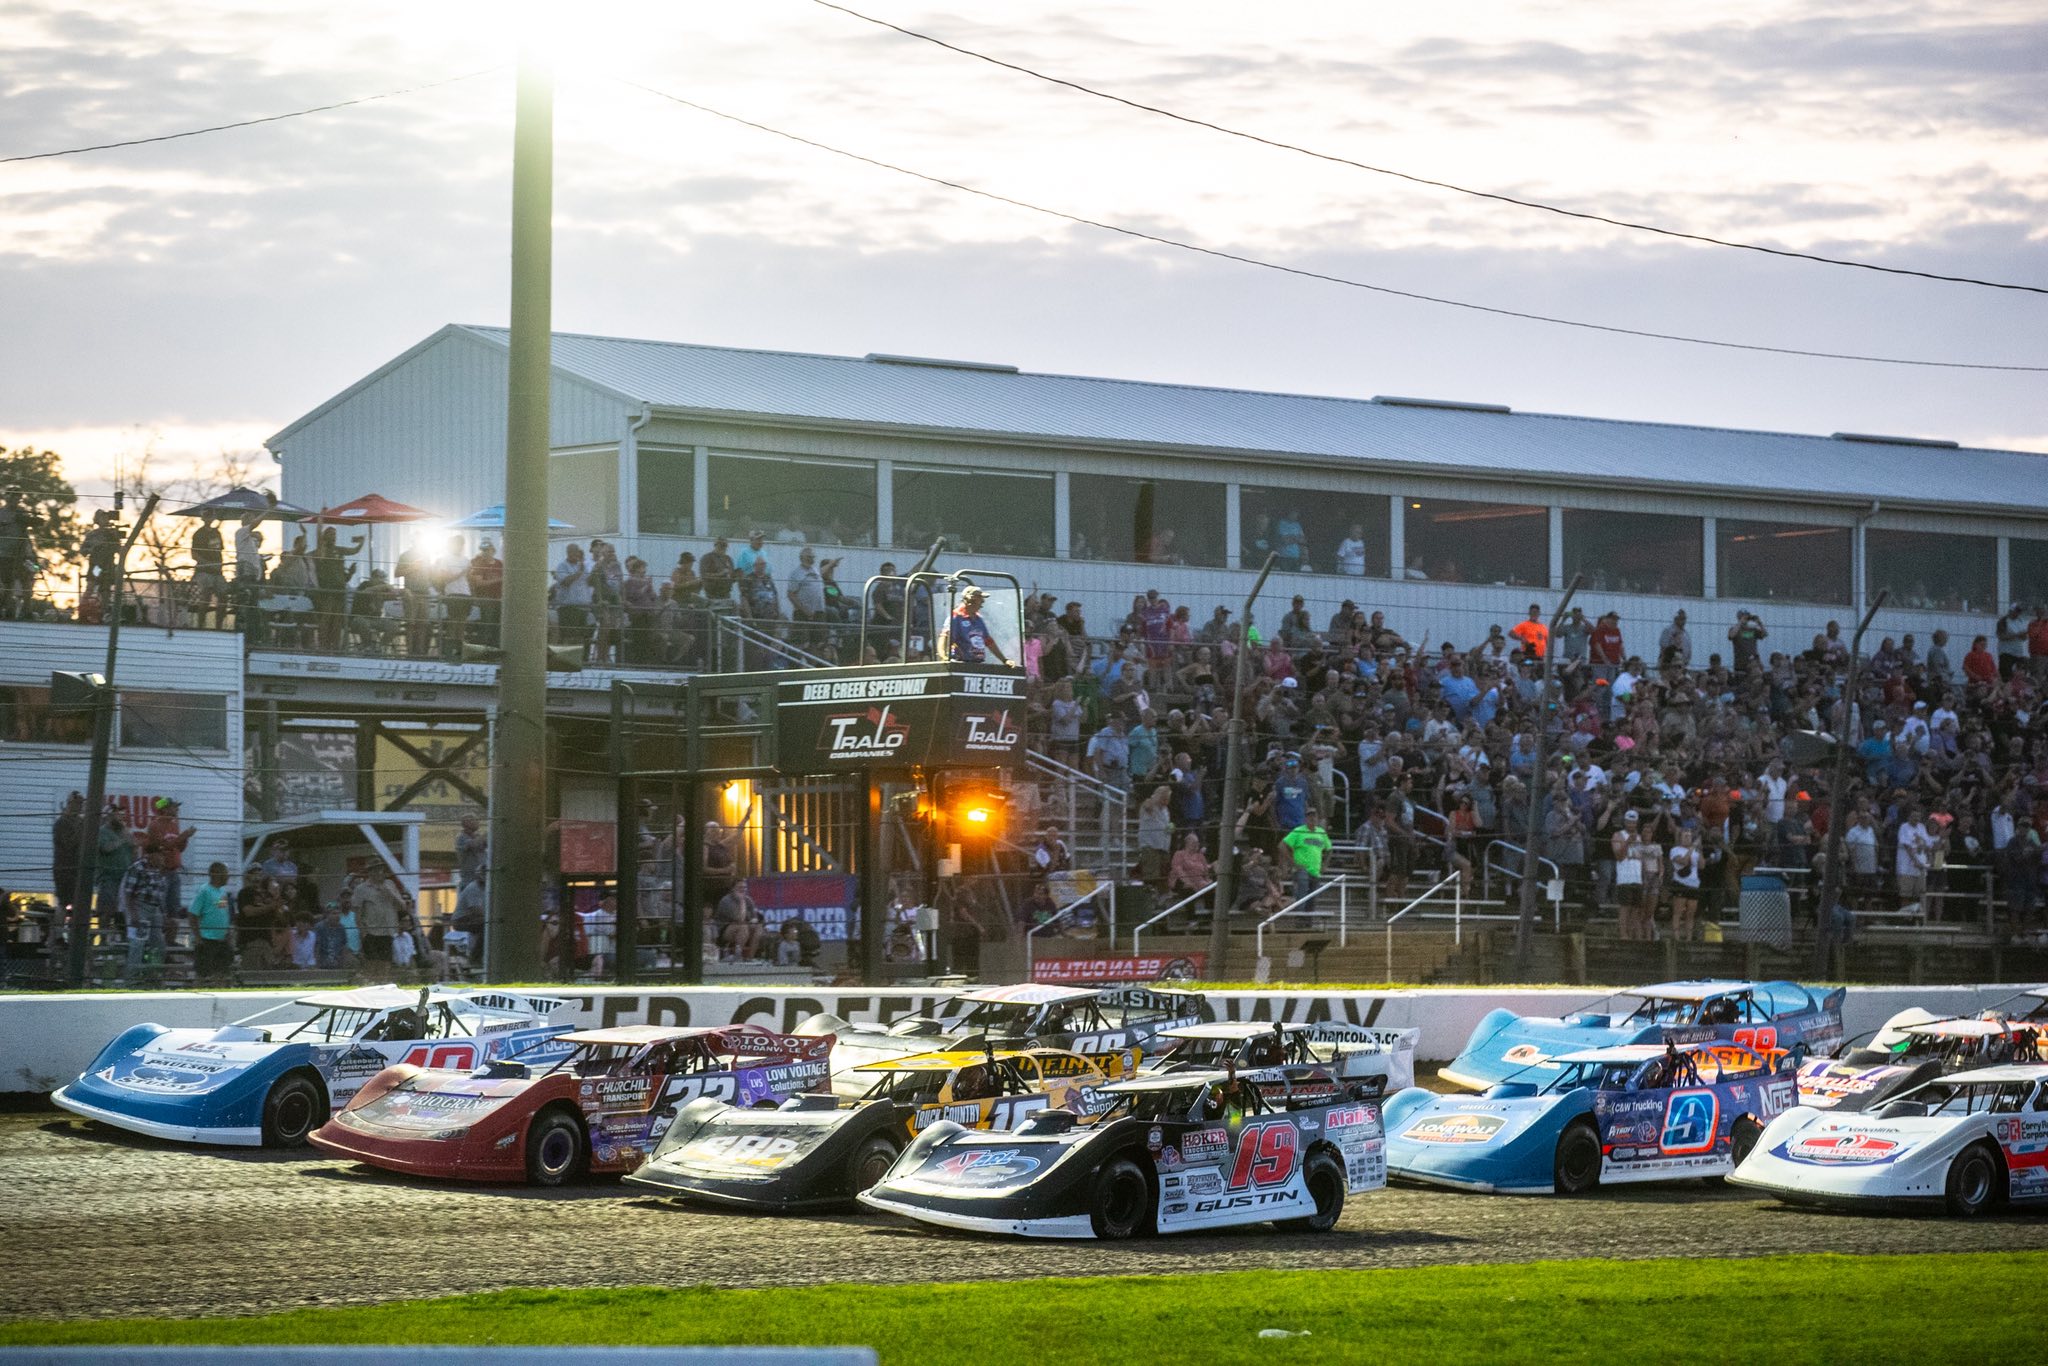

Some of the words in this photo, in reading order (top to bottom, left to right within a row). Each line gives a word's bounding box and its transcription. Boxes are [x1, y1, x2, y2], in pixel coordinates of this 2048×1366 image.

[802, 682, 831, 700] DEER
[832, 680, 868, 699] CREEK
[867, 678, 928, 697] SPEEDWAY
[963, 676, 983, 693] THE
[983, 677, 1014, 695] CREEK
[829, 750, 894, 759] COMPANIES
[965, 743, 1012, 752] COMPANIES
[483, 1023, 508, 1034] STANTON
[508, 1020, 532, 1031] ELECTRIC
[740, 1035, 813, 1047] TOYOT
[146, 1059, 220, 1073] PAULSON
[765, 1067, 788, 1081] LOW
[788, 1062, 827, 1078] VOLTAGE
[595, 1079, 652, 1093] CHURCHILL
[750, 1078, 764, 1089] LVS
[602, 1092, 647, 1102] TRANSPORT
[1758, 1079, 1795, 1116] NOS
[1615, 1101, 1631, 1113] C&W
[1631, 1100, 1663, 1112] Trucking
[914, 1108, 941, 1130] TRUCK
[942, 1103, 981, 1123] COUNTRY
[1327, 1106, 1377, 1128] Alan's
[1183, 1131, 1227, 1147] HOKER
[1184, 1145, 1215, 1154] TRUCKING
[1229, 1123, 1297, 1189] 19
[1195, 1189, 1298, 1212] GUSTIN
